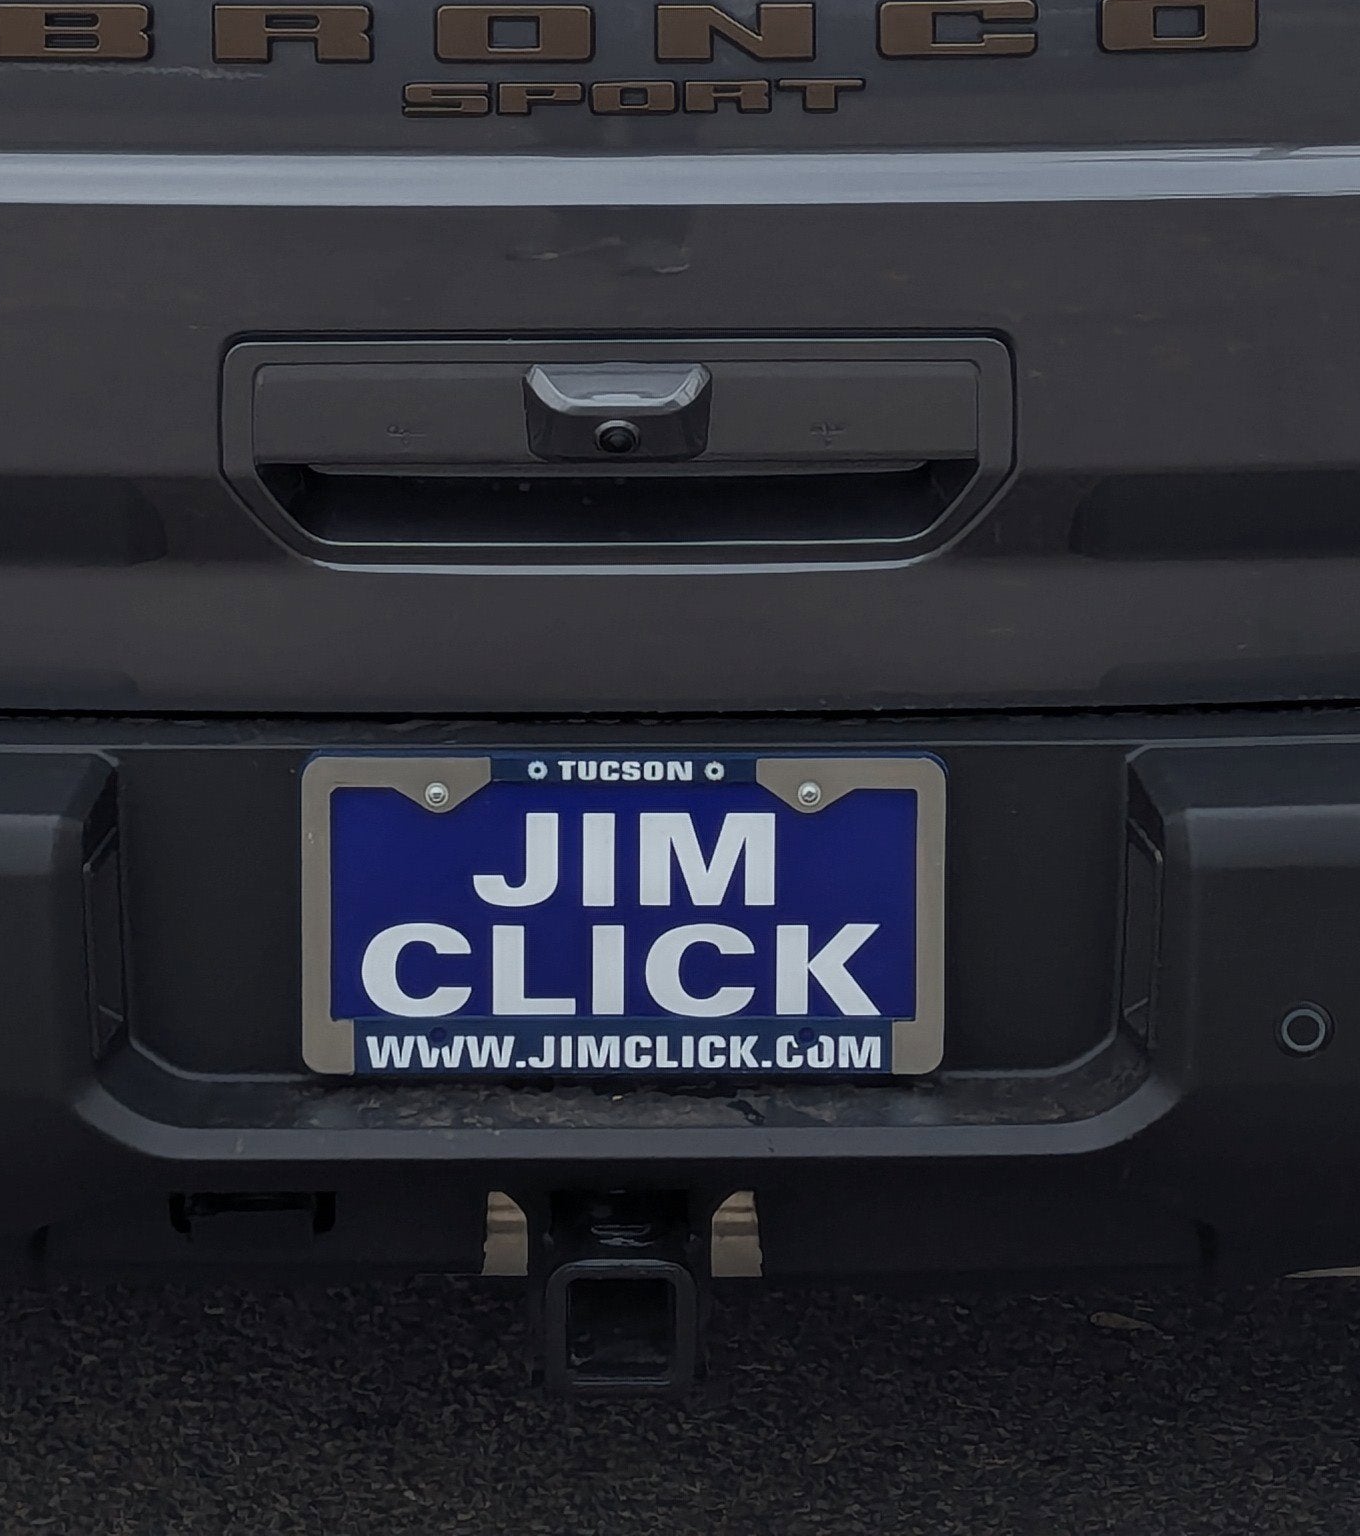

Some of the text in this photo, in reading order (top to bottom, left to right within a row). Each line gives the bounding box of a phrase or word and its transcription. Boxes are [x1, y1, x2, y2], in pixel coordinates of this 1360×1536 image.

[401, 77, 866, 118] SPORT
[558, 760, 693, 782] TUCSON
[472, 811, 776, 908] JIM
[360, 923, 881, 1018] CLICK
[366, 1034, 883, 1070] WWW.JIMCLICK.COM
